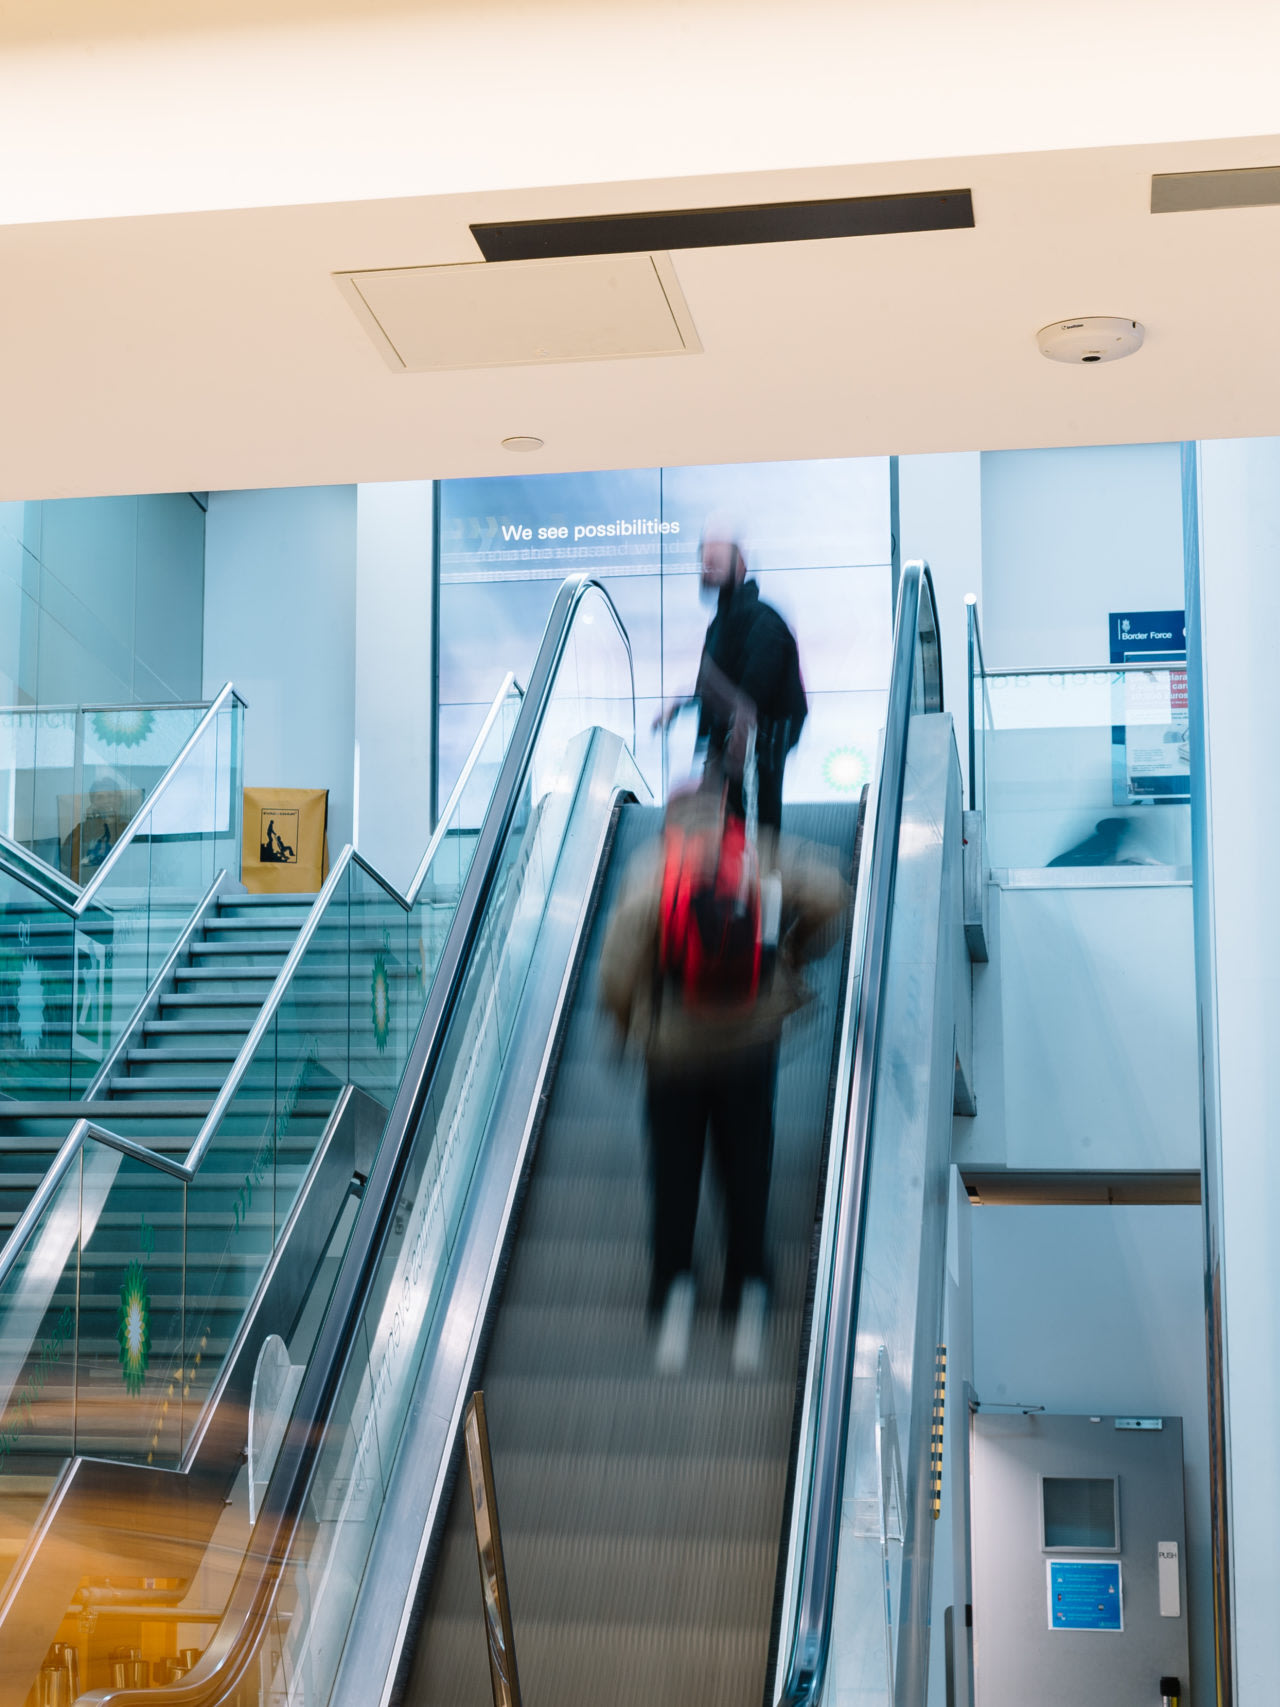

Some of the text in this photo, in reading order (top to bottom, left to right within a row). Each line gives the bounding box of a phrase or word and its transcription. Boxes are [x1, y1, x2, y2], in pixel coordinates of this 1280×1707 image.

[501, 517, 681, 542] We see possibilities
[1122, 631, 1173, 641] Border Force
